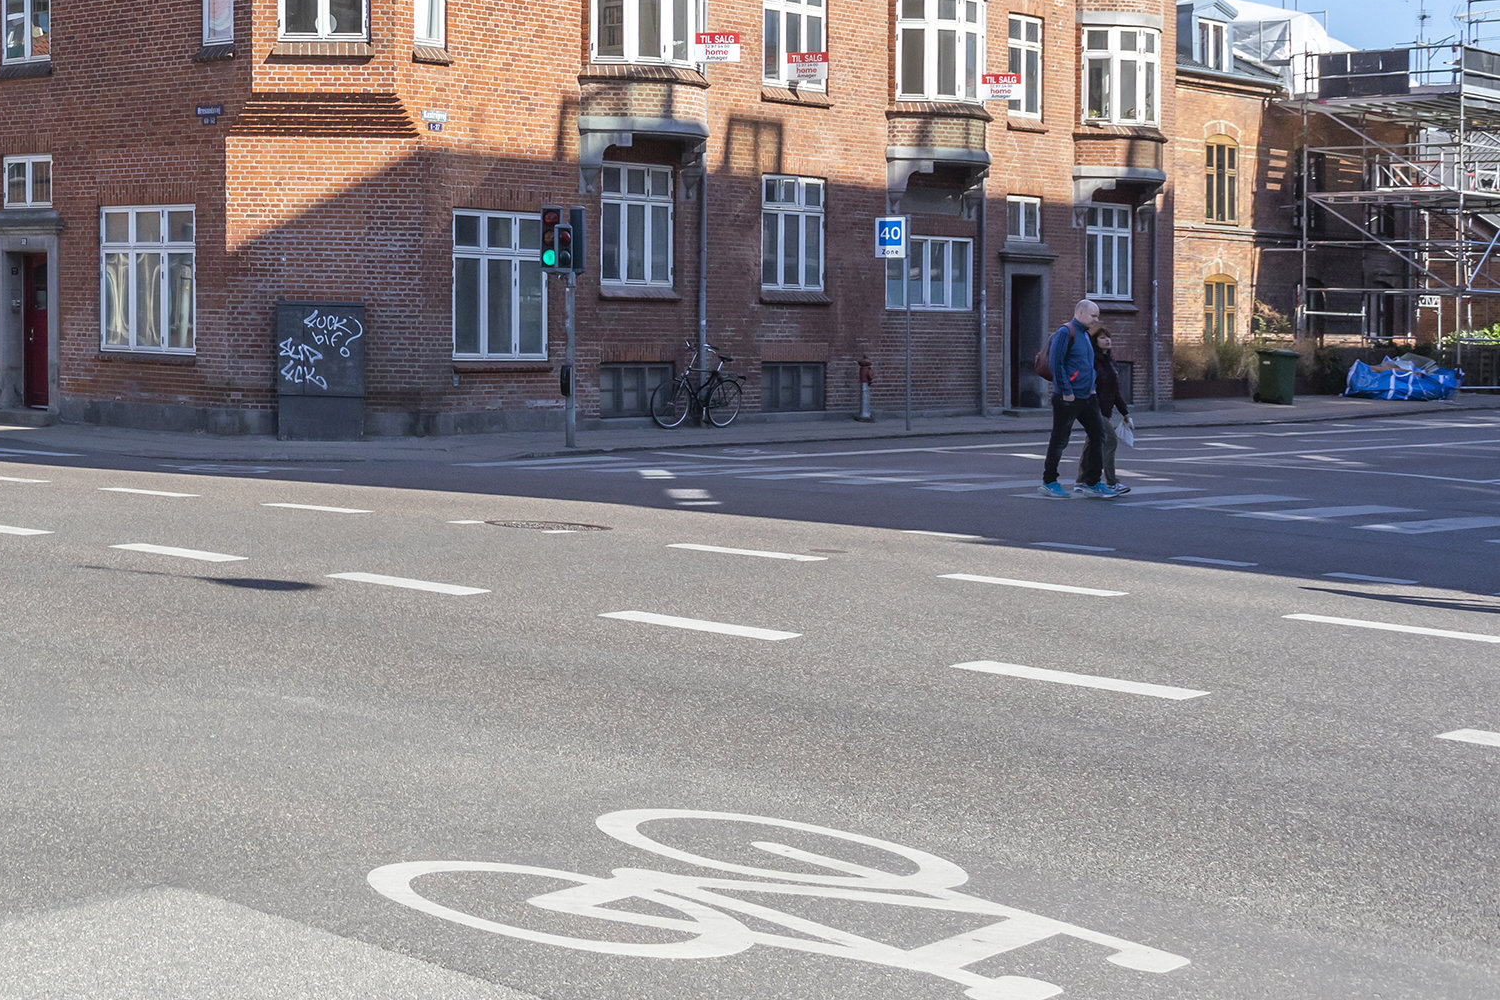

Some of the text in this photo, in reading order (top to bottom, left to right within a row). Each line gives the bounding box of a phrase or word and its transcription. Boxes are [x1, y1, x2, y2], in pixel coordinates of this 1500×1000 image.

[700, 35, 735, 43] TIL SALG
[804, 54, 823, 62] SALG
[880, 226, 901, 240] 40
